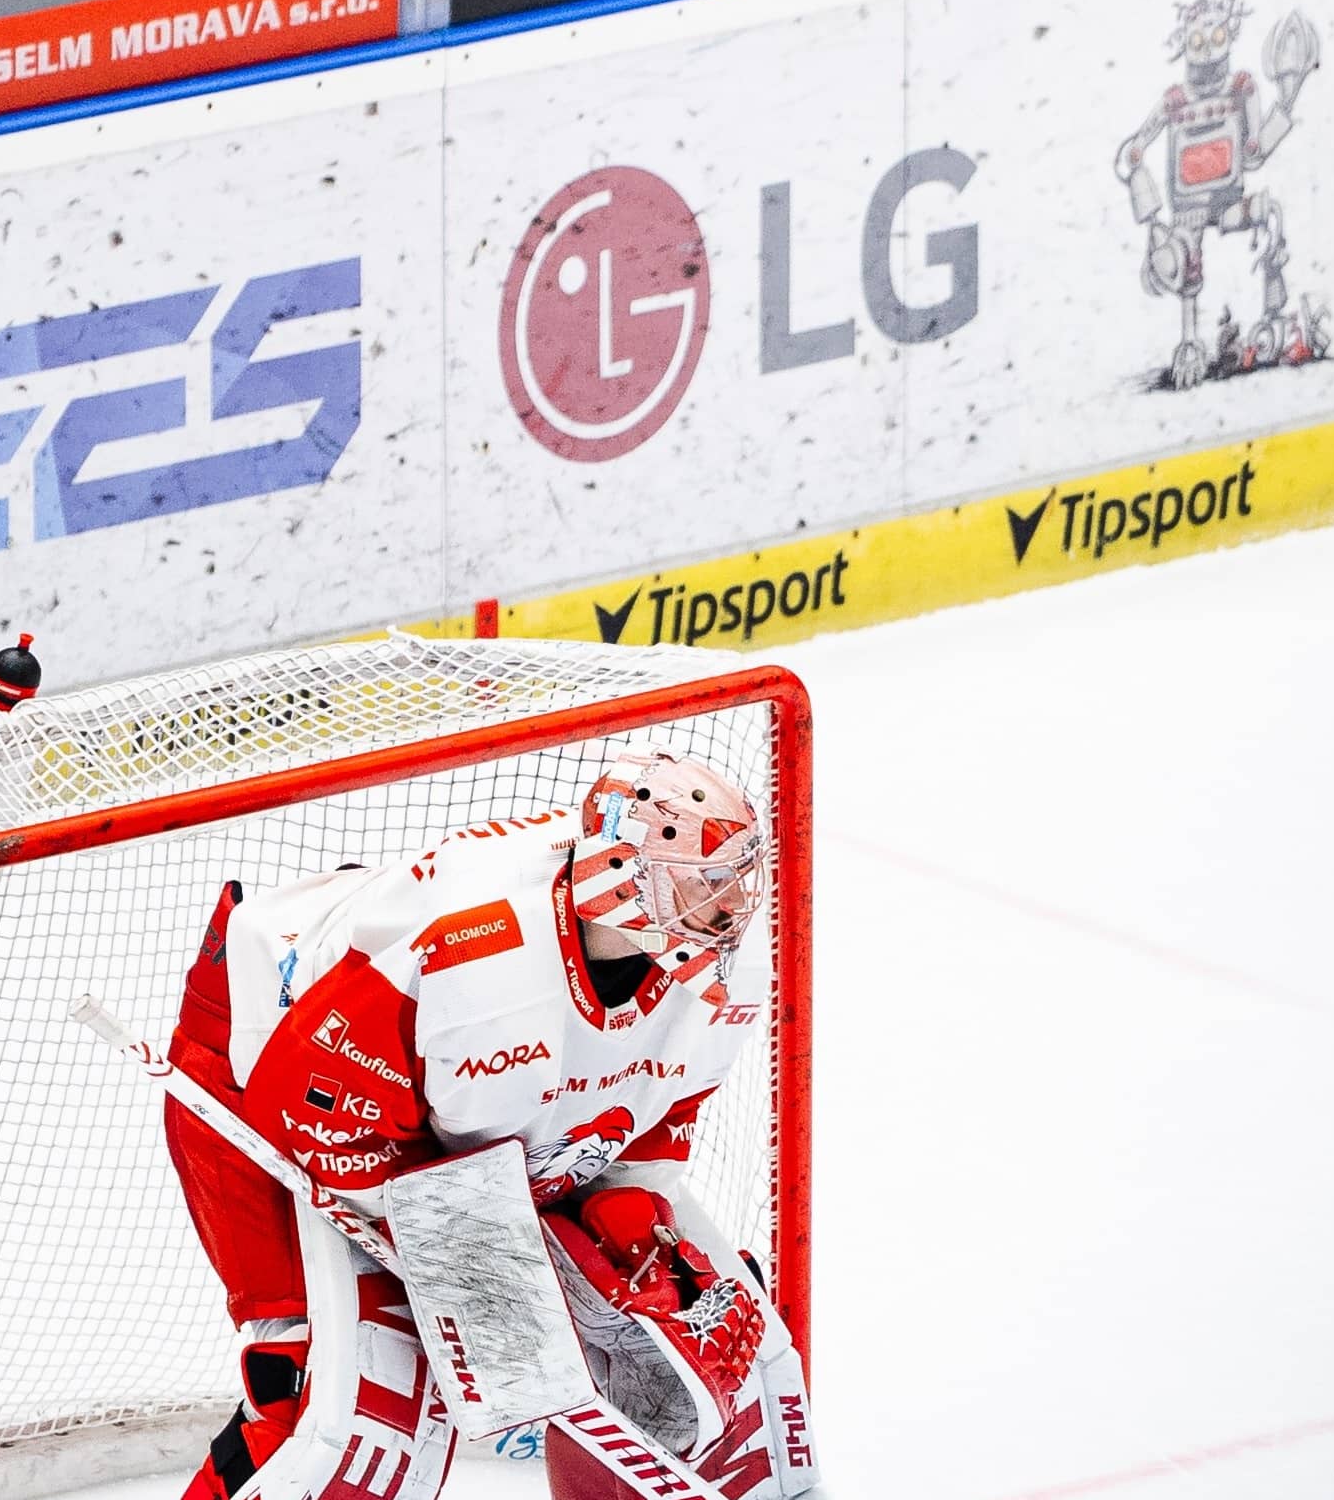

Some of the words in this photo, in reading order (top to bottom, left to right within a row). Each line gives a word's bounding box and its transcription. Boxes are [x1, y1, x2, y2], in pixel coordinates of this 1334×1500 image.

[759, 146, 980, 376] LG
[1058, 459, 1257, 558] Tipsport
[648, 549, 849, 646] Tipsport
[444, 919, 508, 946] OLOMOUC
[554, 886, 570, 937] Tipsport
[567, 969, 595, 1016] Tipsport
[454, 1040, 551, 1080] MORA
[597, 1058, 686, 1092] MORAVA
[341, 1092, 382, 1121] KB
[315, 1139, 403, 1177] Tipsport
